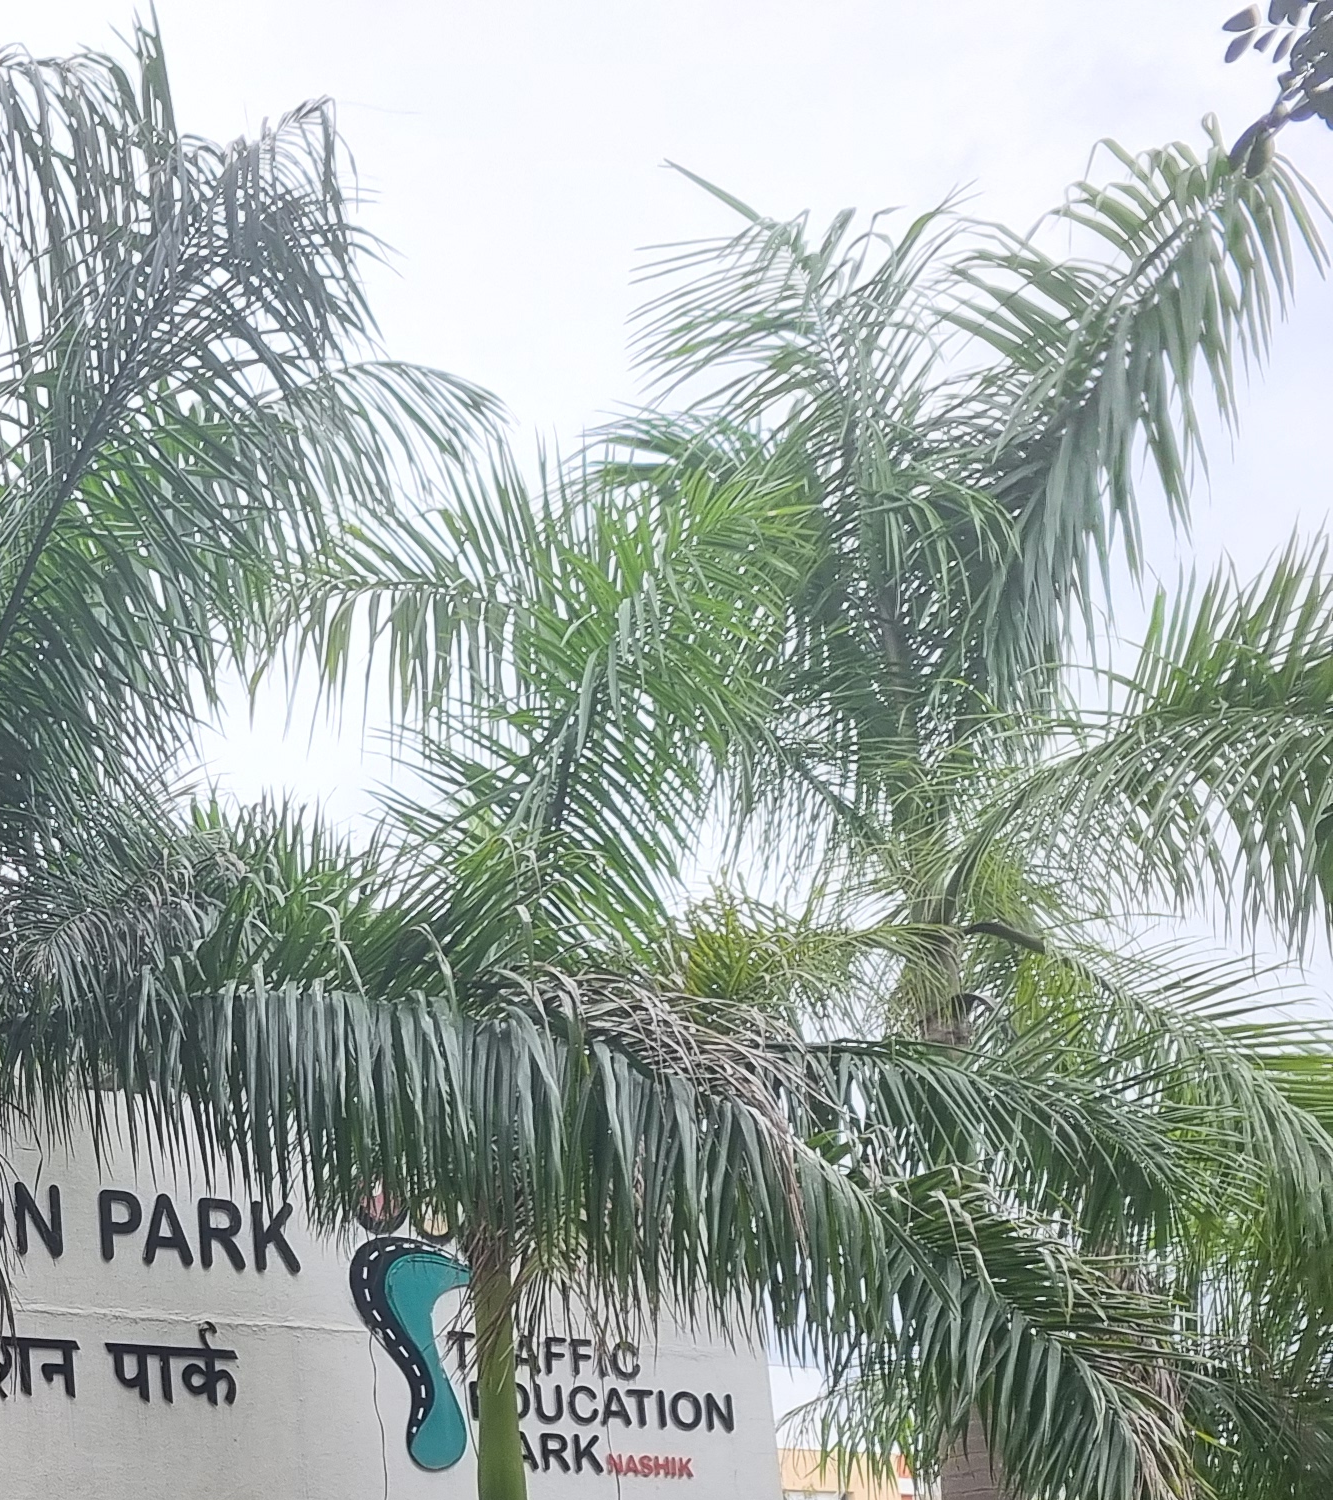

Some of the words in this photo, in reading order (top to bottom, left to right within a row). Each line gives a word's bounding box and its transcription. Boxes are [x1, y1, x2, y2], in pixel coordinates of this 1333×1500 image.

[98, 1188, 302, 1275] PARK
[104, 1320, 239, 1407] पार्क
[446, 1329, 641, 1380] TAFFIC
[519, 1431, 605, 1474] ARK
[605, 1453, 694, 1479] NASHIK
